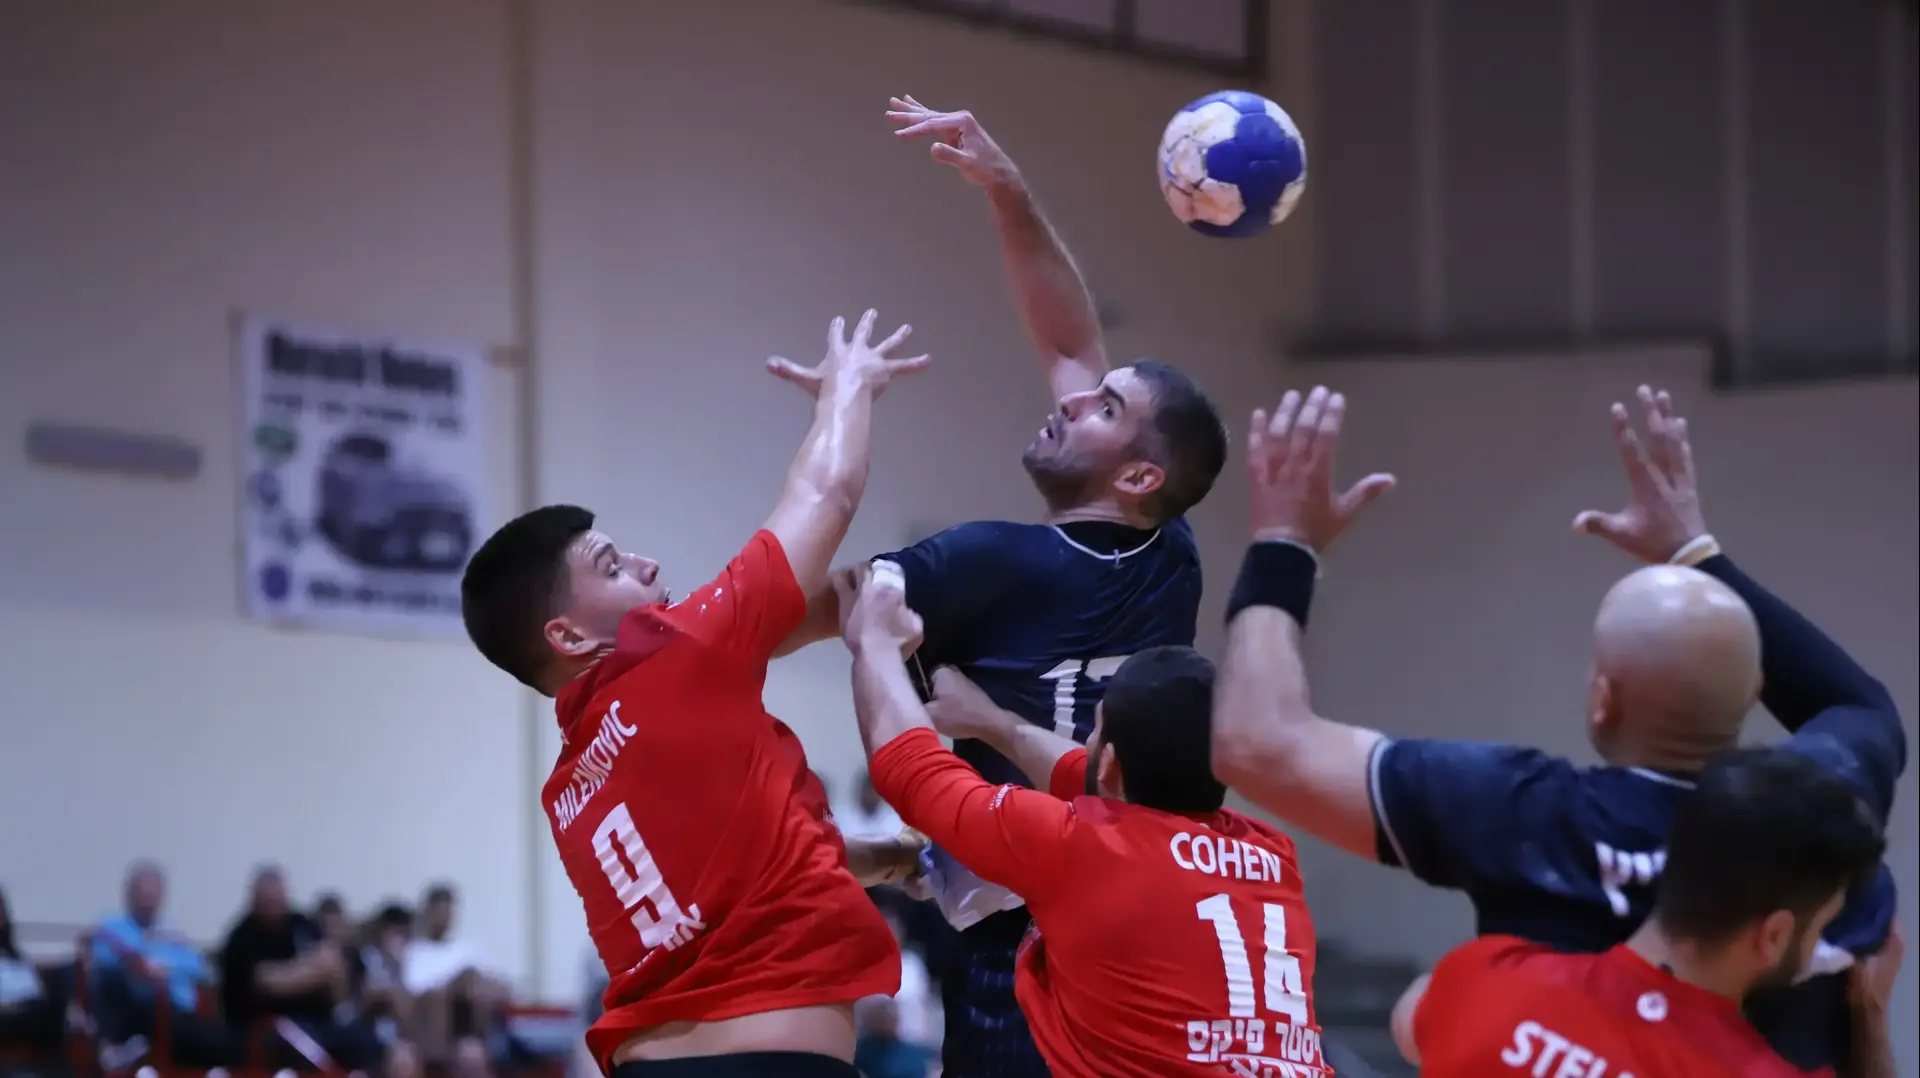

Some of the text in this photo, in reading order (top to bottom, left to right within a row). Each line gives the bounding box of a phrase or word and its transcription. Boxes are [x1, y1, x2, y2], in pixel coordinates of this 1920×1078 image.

[1038, 655, 1131, 740] 1
[591, 801, 688, 949] 9
[1169, 832, 1281, 884] COHEN
[1196, 893, 1309, 1027] 14
